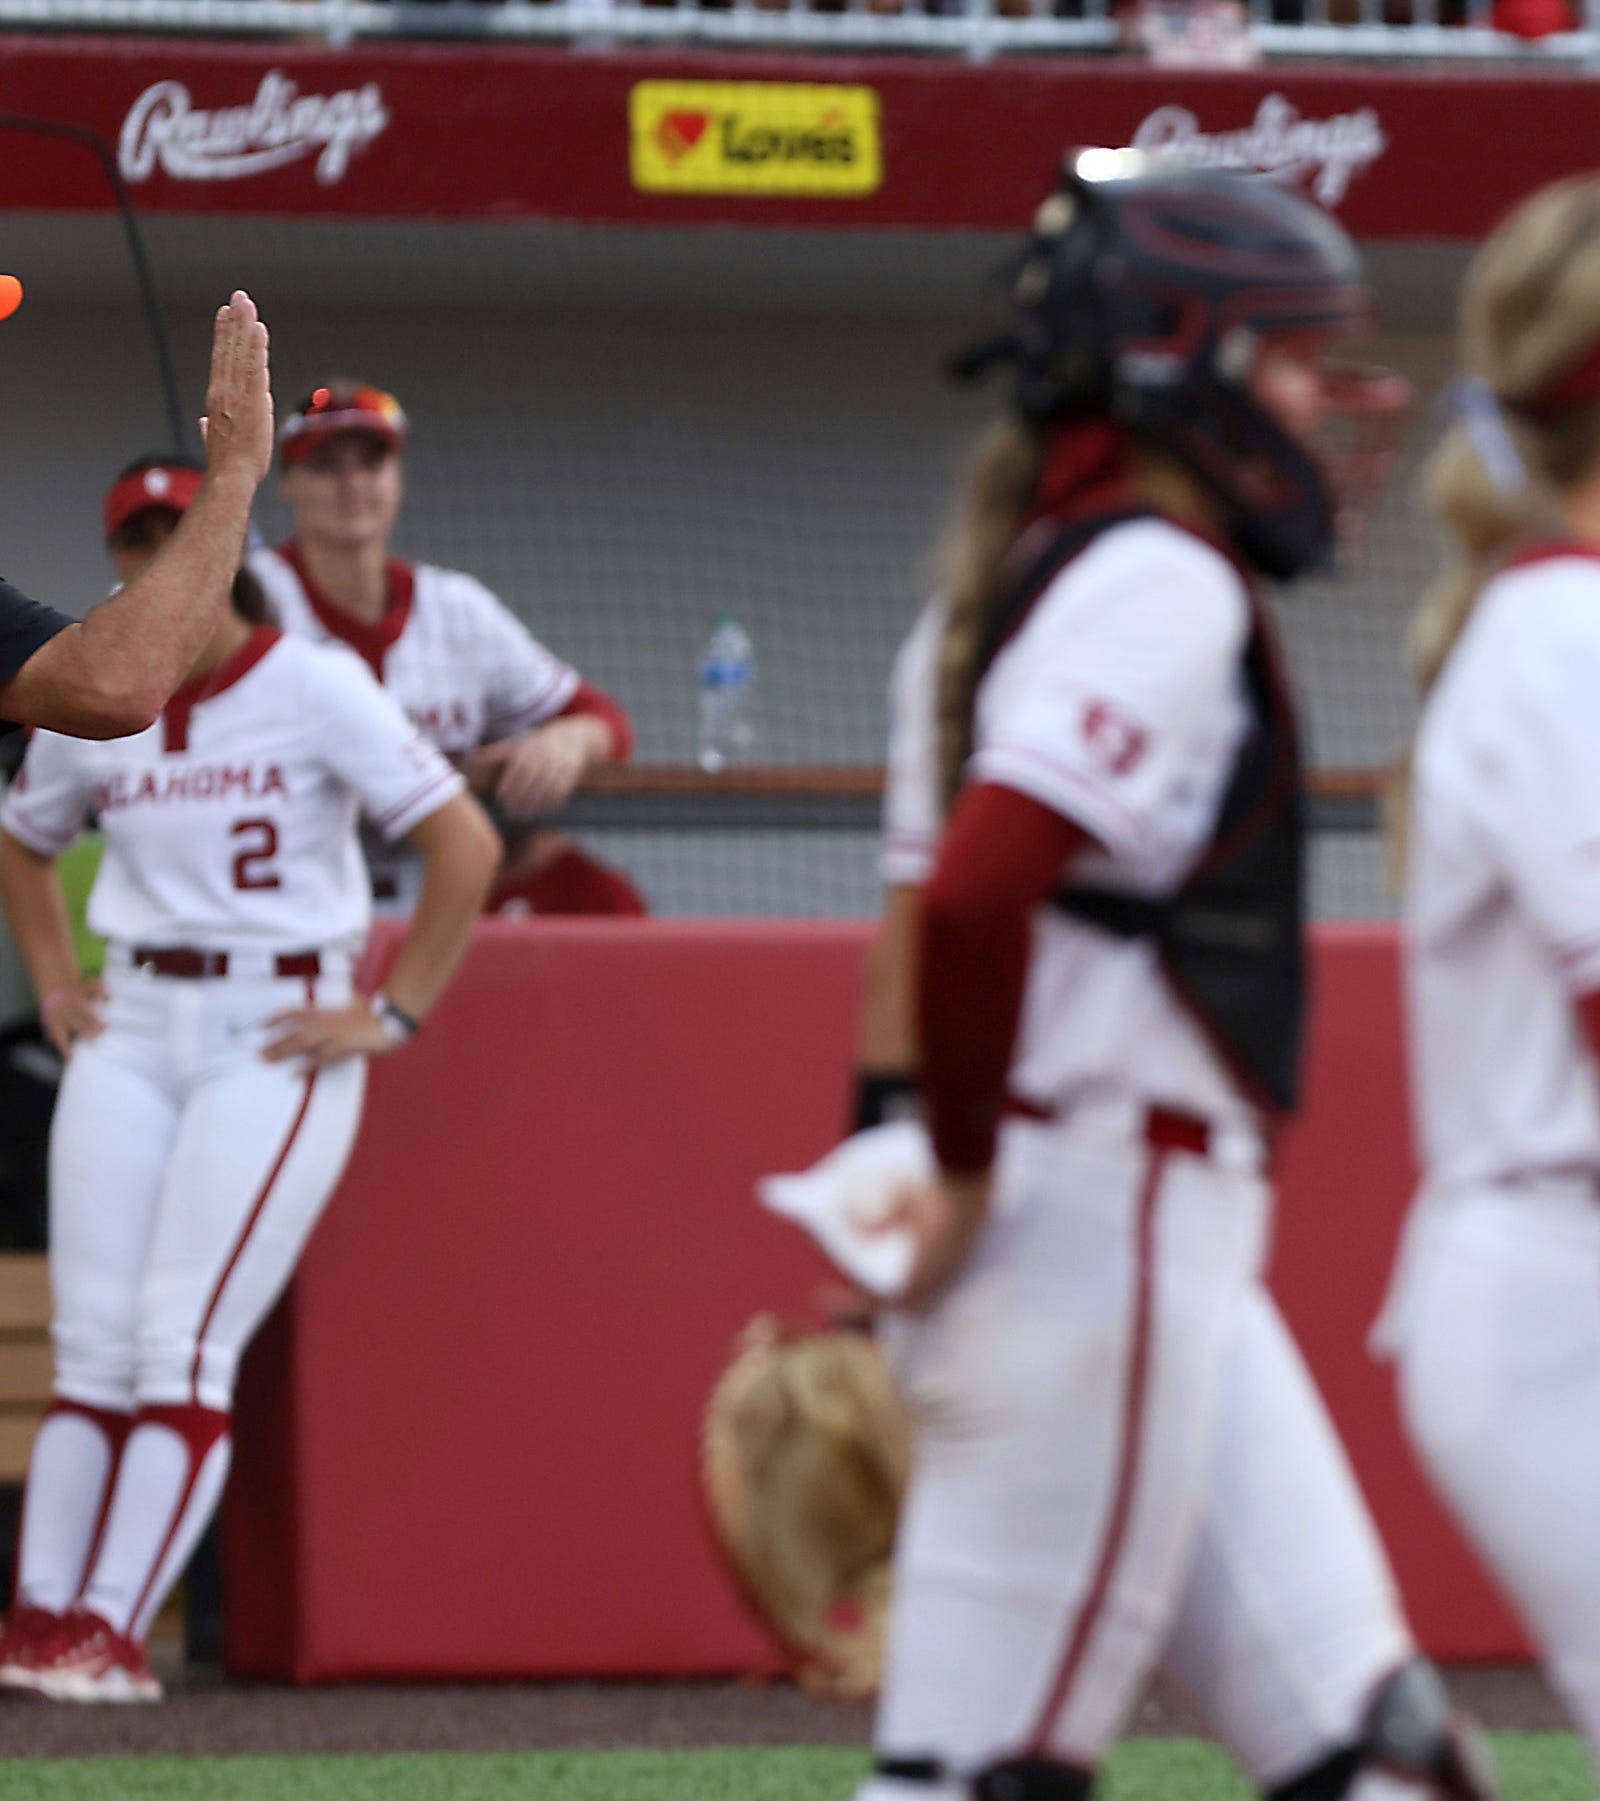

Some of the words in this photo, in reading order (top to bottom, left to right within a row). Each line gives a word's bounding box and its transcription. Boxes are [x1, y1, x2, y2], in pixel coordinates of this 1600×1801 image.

[118, 68, 390, 186] Rawlings
[1130, 93, 1387, 206] Rawlings
[229, 816, 282, 891] 2
